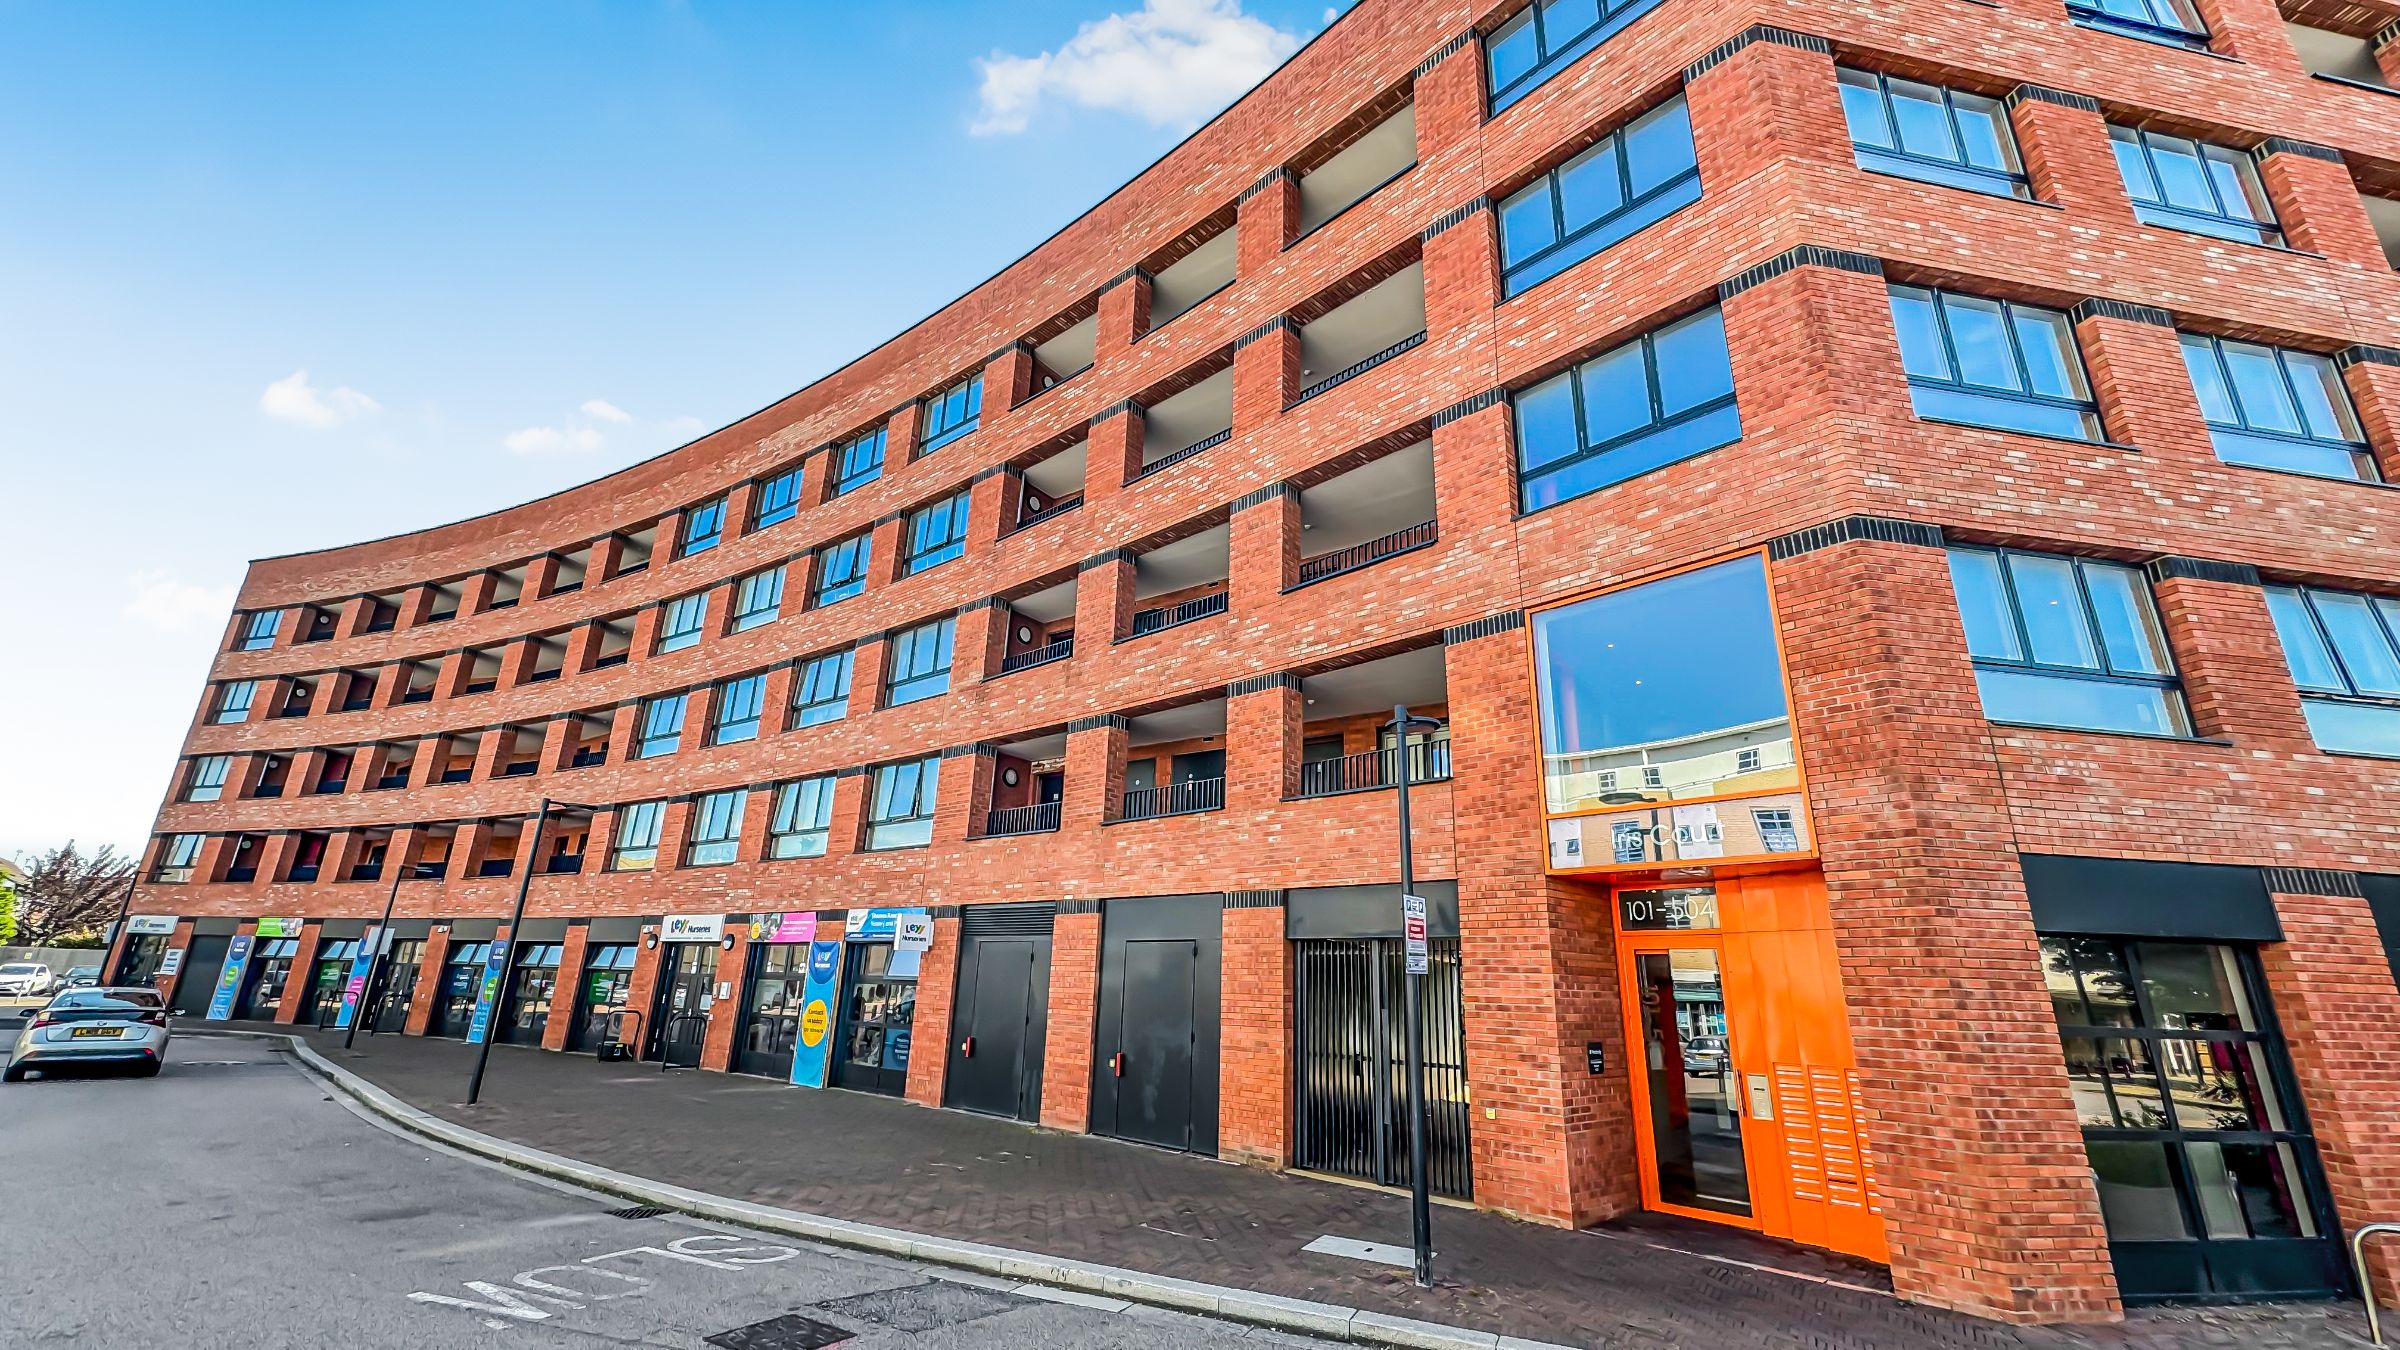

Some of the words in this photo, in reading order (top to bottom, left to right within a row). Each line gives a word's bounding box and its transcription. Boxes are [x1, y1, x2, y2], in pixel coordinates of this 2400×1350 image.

[1626, 896, 1714, 922] 101-504
[687, 925, 712, 933] Nurseries
[405, 1235, 802, 1320] SLOW
